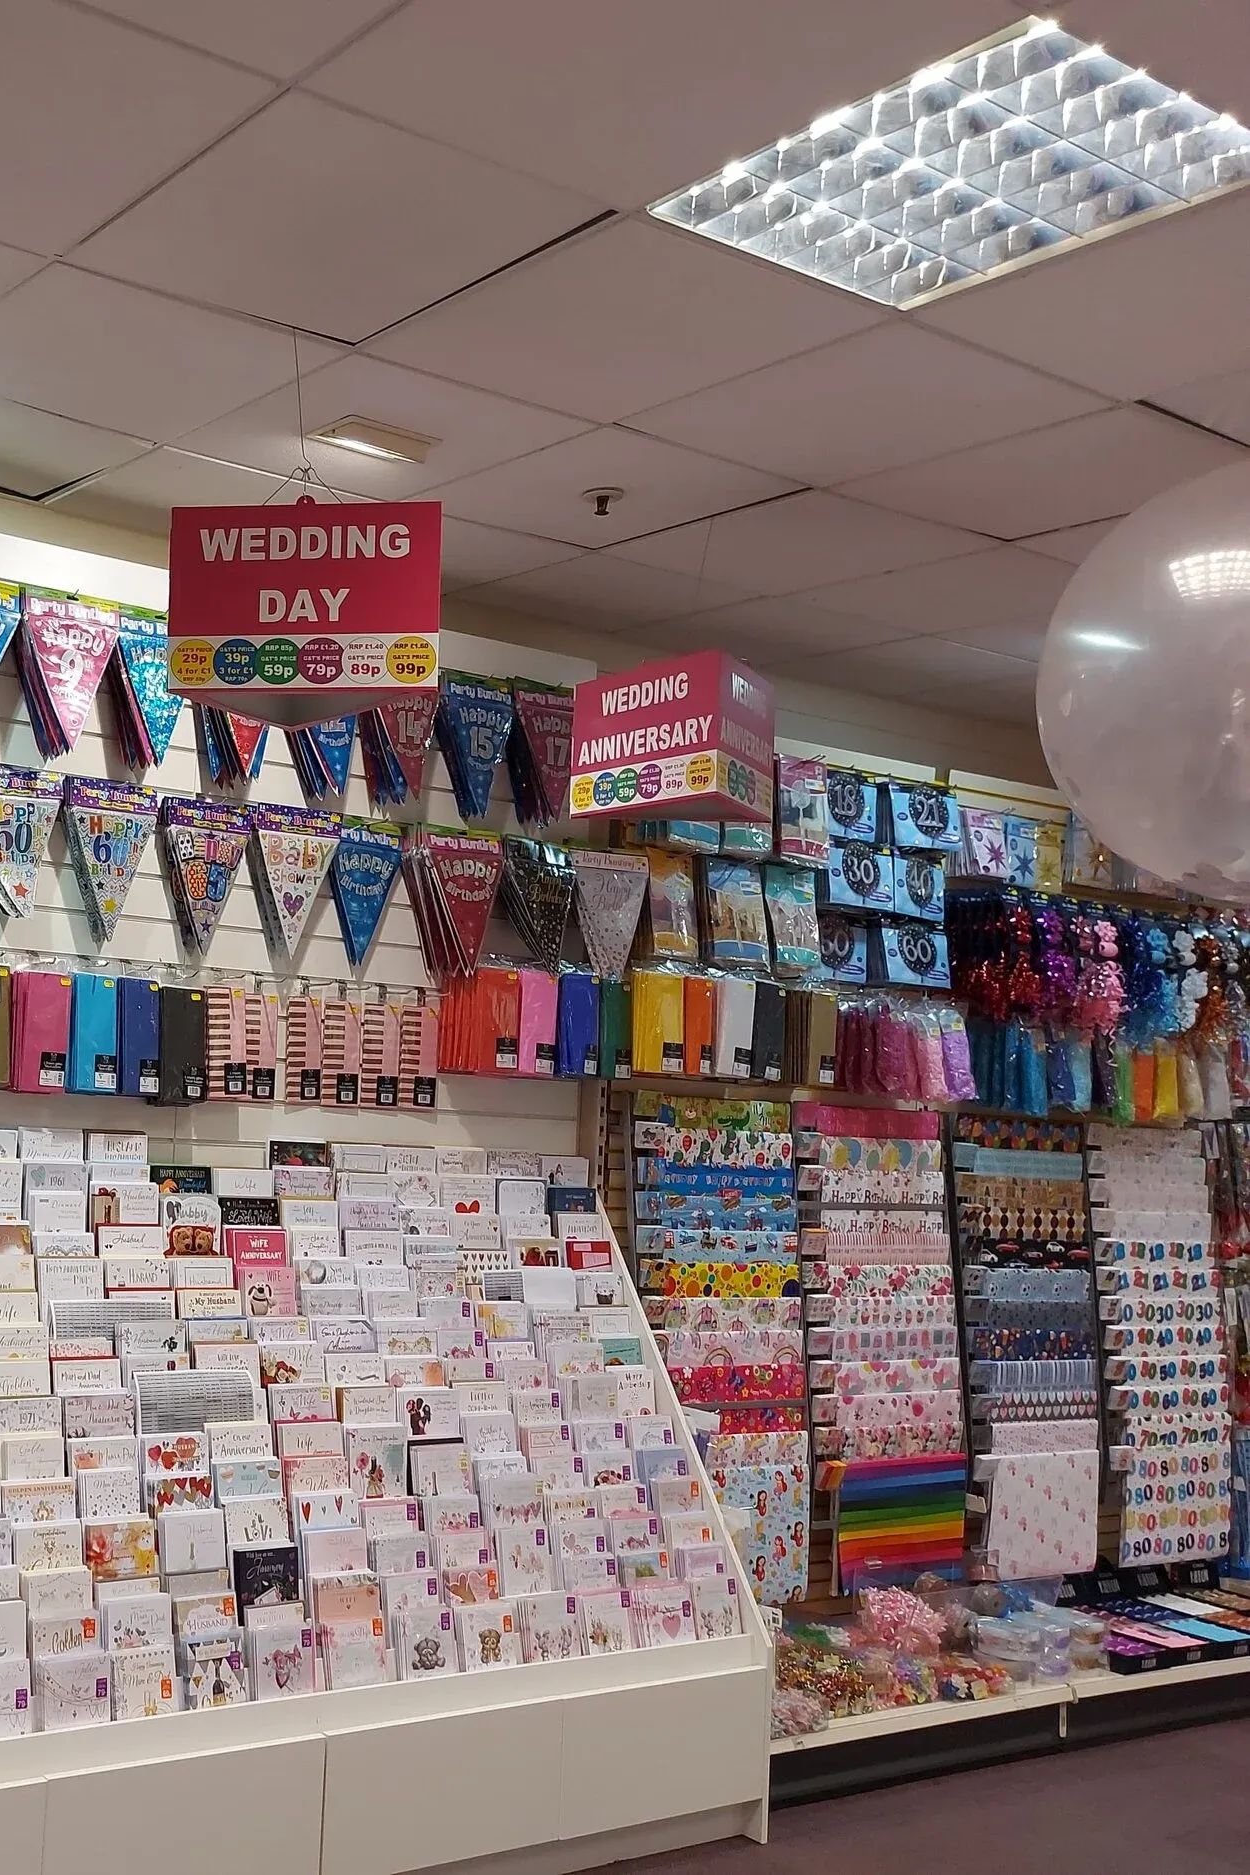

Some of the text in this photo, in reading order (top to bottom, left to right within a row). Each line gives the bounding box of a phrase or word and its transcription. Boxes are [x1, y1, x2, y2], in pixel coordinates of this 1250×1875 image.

[200, 524, 410, 562] WEDDING
[259, 588, 350, 623] DAY
[182, 653, 207, 665] 29p
[225, 652, 249, 664] 39p
[264, 665, 293, 678] 59p
[306, 664, 337, 678] 79p
[350, 664, 381, 677] 89p
[396, 663, 426, 677] 99p
[451, 683, 476, 700] Party
[602, 672, 689, 717] WEDDING
[459, 707, 506, 732] Happy
[578, 714, 714, 766] ANNIVERSARY
[641, 783, 658, 793] 79p
[666, 779, 683, 790] 89p
[691, 776, 709, 785] 99p
[619, 788, 634, 799] 59p
[834, 785, 858, 816] 18
[916, 796, 944, 828] 21
[430, 834, 458, 849] Party
[266, 835, 331, 869] Baby
[338, 852, 394, 879] Happy
[439, 858, 498, 884] Happy
[847, 856, 874, 884] 30
[903, 935, 931, 963] 60
[241, 1251, 282, 1260] ANNIVERSARY
[207, 1296, 236, 1305] Husband
[1156, 1304, 1173, 1324] 30
[0, 1378, 32, 1394] Golden
[19, 1413, 36, 1424] 1971
[1135, 1485, 1152, 1505] 80
[1178, 1480, 1195, 1501] 80
[1133, 1537, 1151, 1557] 80
[1177, 1533, 1194, 1552] 80
[187, 1616, 228, 1631] HUSBAND
[52, 1631, 83, 1655] Golden
